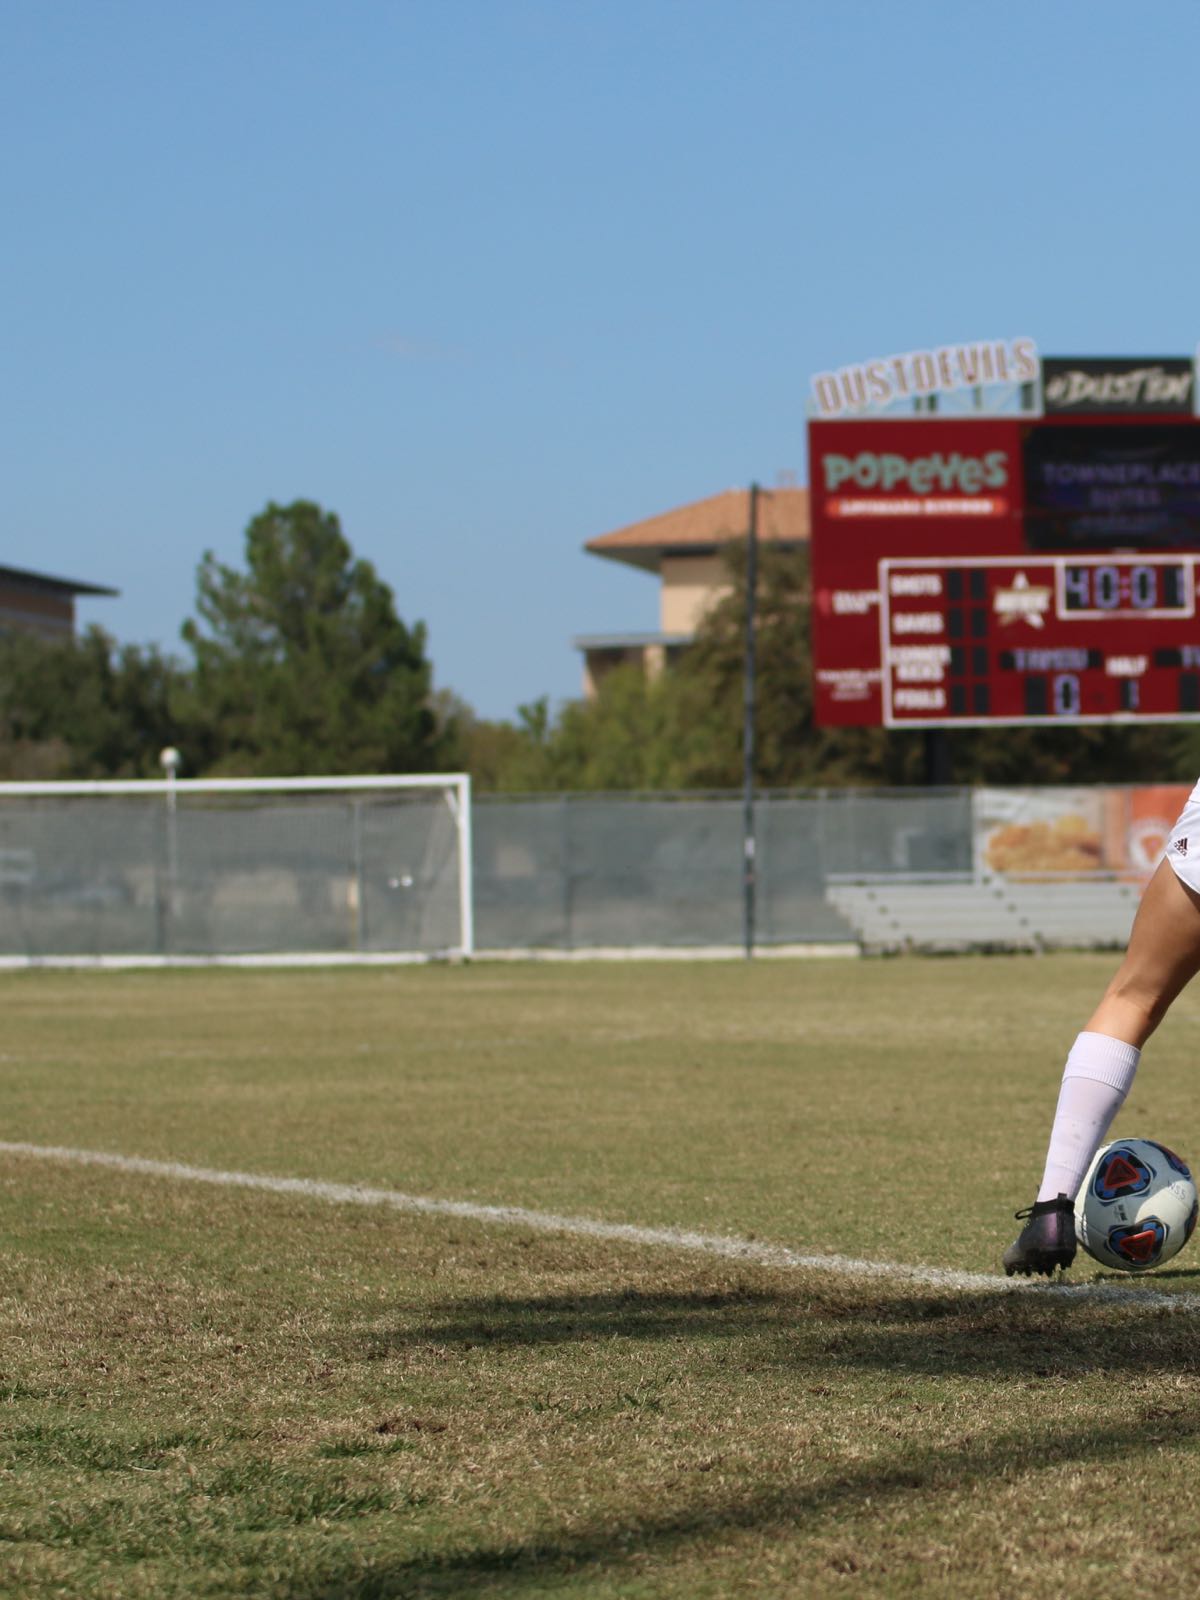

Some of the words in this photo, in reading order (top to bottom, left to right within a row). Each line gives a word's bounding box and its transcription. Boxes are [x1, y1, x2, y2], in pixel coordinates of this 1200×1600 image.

[812, 340, 1037, 416] DUSTDEVILS
[1065, 566, 1186, 608] 40:01
[1106, 656, 1148, 676] HALF
[1055, 674, 1080, 715] 0
